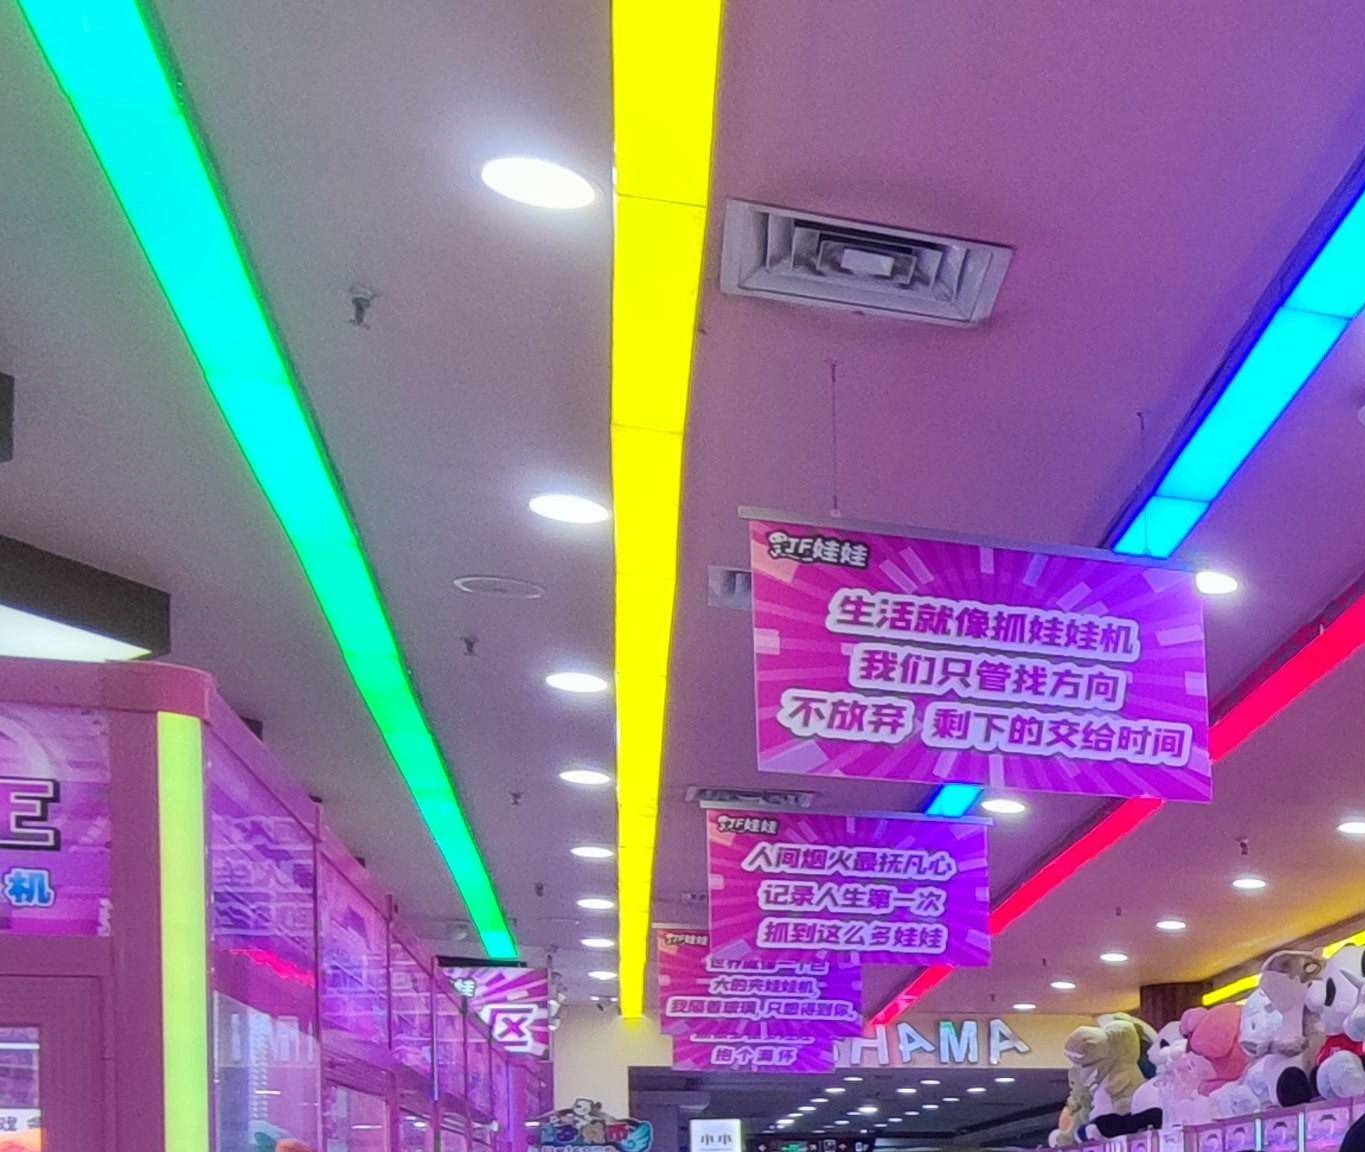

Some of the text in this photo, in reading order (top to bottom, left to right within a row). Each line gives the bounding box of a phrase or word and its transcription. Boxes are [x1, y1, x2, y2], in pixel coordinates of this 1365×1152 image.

[834, 593, 1136, 656] 生活就像抓娃娃机
[857, 648, 1121, 704] 我们只管找方向
[784, 694, 1188, 763] 不放弃 剩下的交给时间
[744, 843, 956, 879] 人间烟火最抚凡心
[763, 884, 946, 914] 记录人生第一次
[763, 922, 946, 952] 抓到这么多娃娃
[833, 1017, 1031, 1065] HAMA
